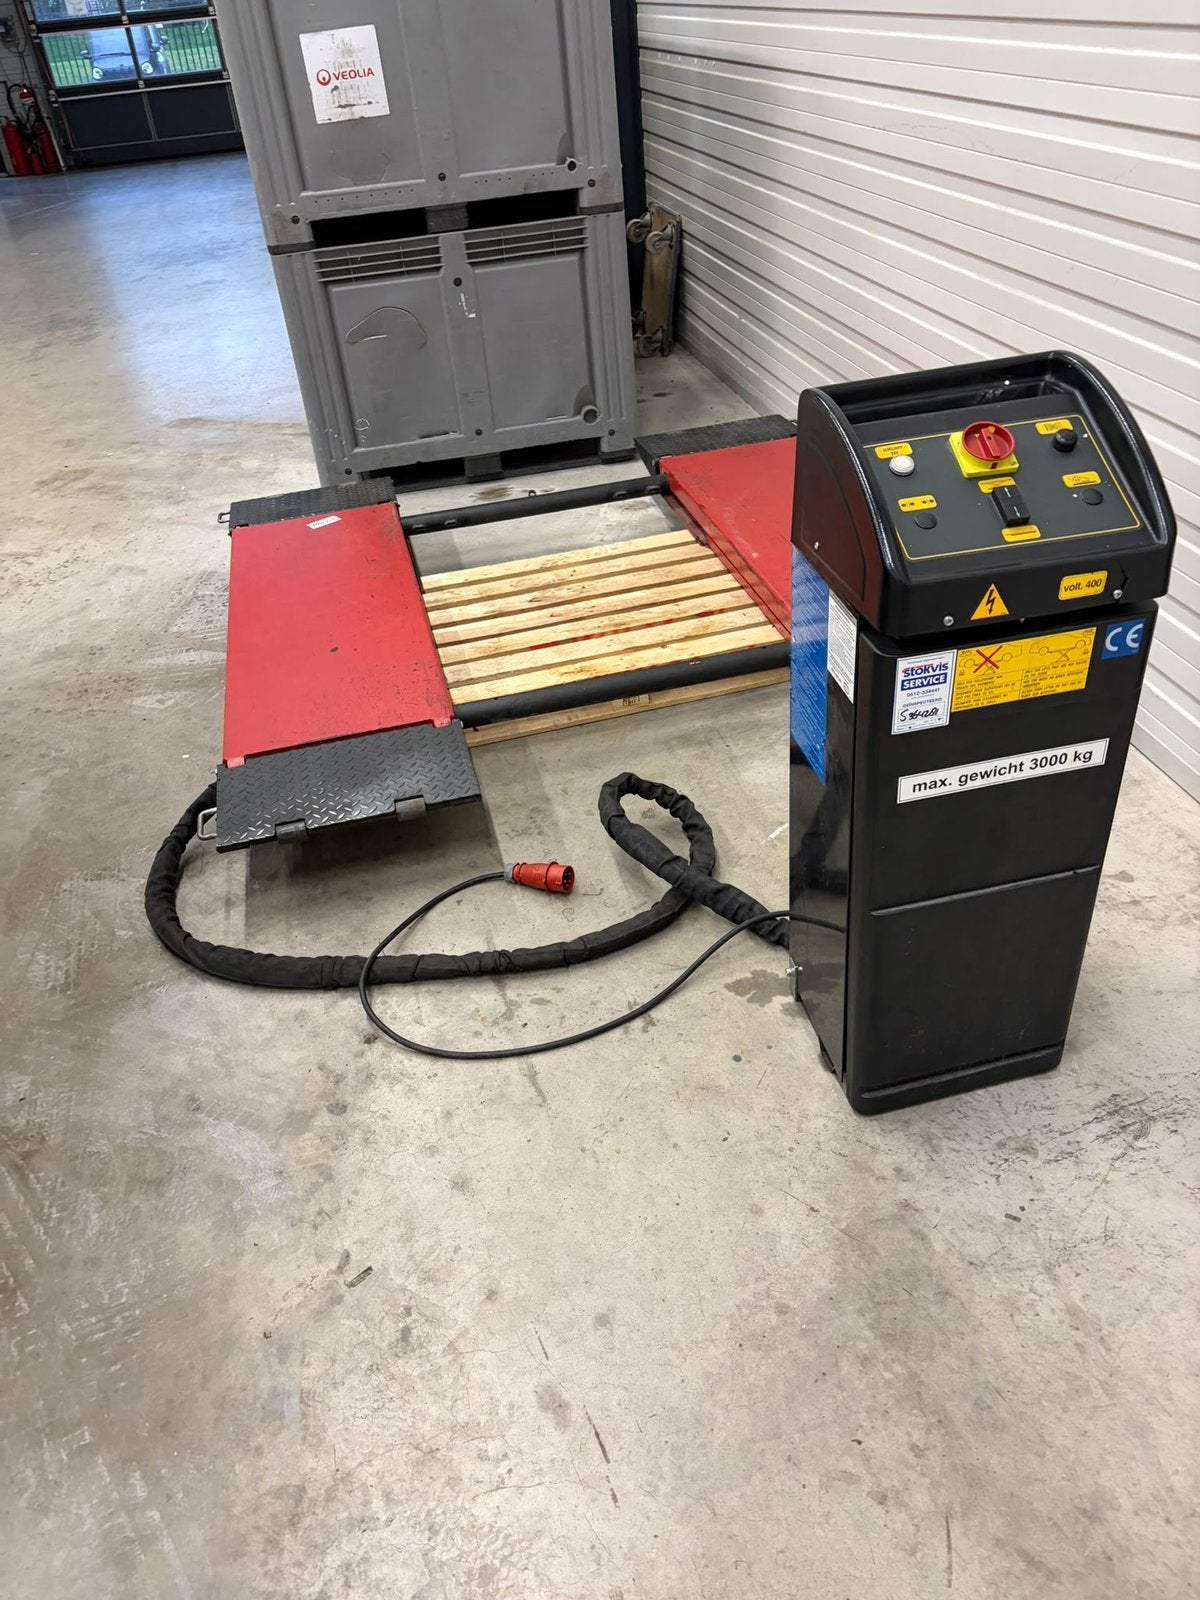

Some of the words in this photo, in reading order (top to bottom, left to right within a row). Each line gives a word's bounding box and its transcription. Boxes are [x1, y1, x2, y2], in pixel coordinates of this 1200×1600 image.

[333, 67, 375, 81] VEOLIA
[1064, 582, 1083, 592] volt.
[1085, 578, 1102, 588] 400
[1105, 623, 1144, 652] CE
[903, 674, 945, 689] SERVICE
[912, 777, 952, 793] max.
[958, 760, 1025, 786] gewicht
[1029, 752, 1068, 771] 3000
[1073, 749, 1093, 763] kg
